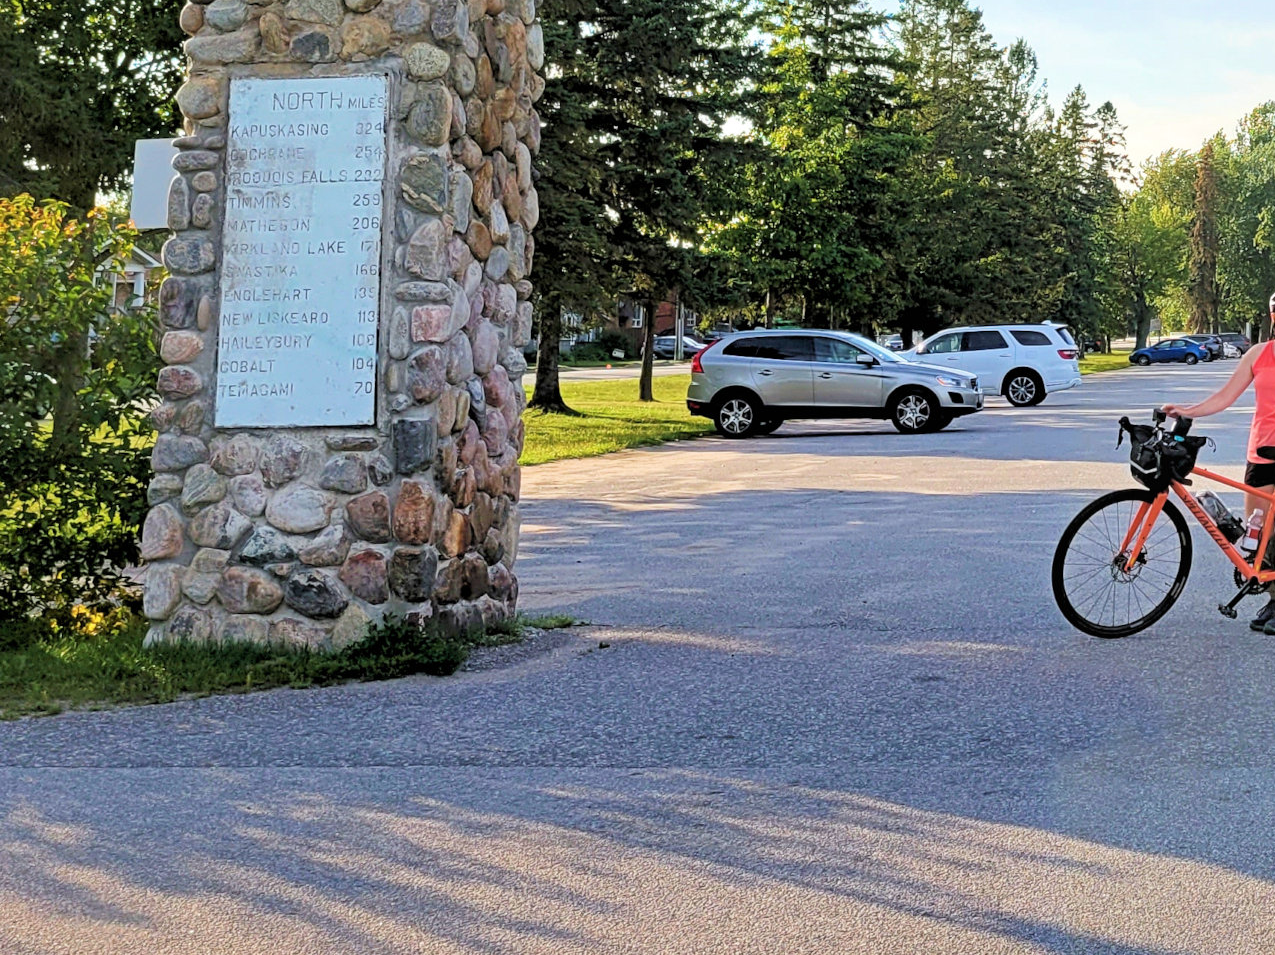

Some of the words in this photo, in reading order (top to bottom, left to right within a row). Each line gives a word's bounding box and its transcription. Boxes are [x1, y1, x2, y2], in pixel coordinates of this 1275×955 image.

[272, 92, 343, 111] NORTH
[347, 97, 384, 109] MILES
[231, 124, 329, 138] KAPUSKASING
[355, 122, 383, 135] 324
[229, 171, 294, 186] ROQUOIS
[302, 170, 348, 183] FALLS
[229, 195, 291, 209] TIMMINS
[227, 219, 310, 232] MATHESON
[352, 216, 379, 229] 206
[307, 241, 346, 255] LAKE
[355, 264, 377, 275] 166
[224, 288, 312, 302] ENGLEHART
[222, 313, 253, 326] NEW
[258, 312, 329, 324] LISKEARD
[358, 311, 375, 323] 113
[221, 335, 312, 350] HAILEYBURY
[220, 359, 276, 373] COBALT
[352, 357, 374, 370] 104
[219, 383, 294, 397] TEMAGAMI
[354, 381, 373, 394] 70
